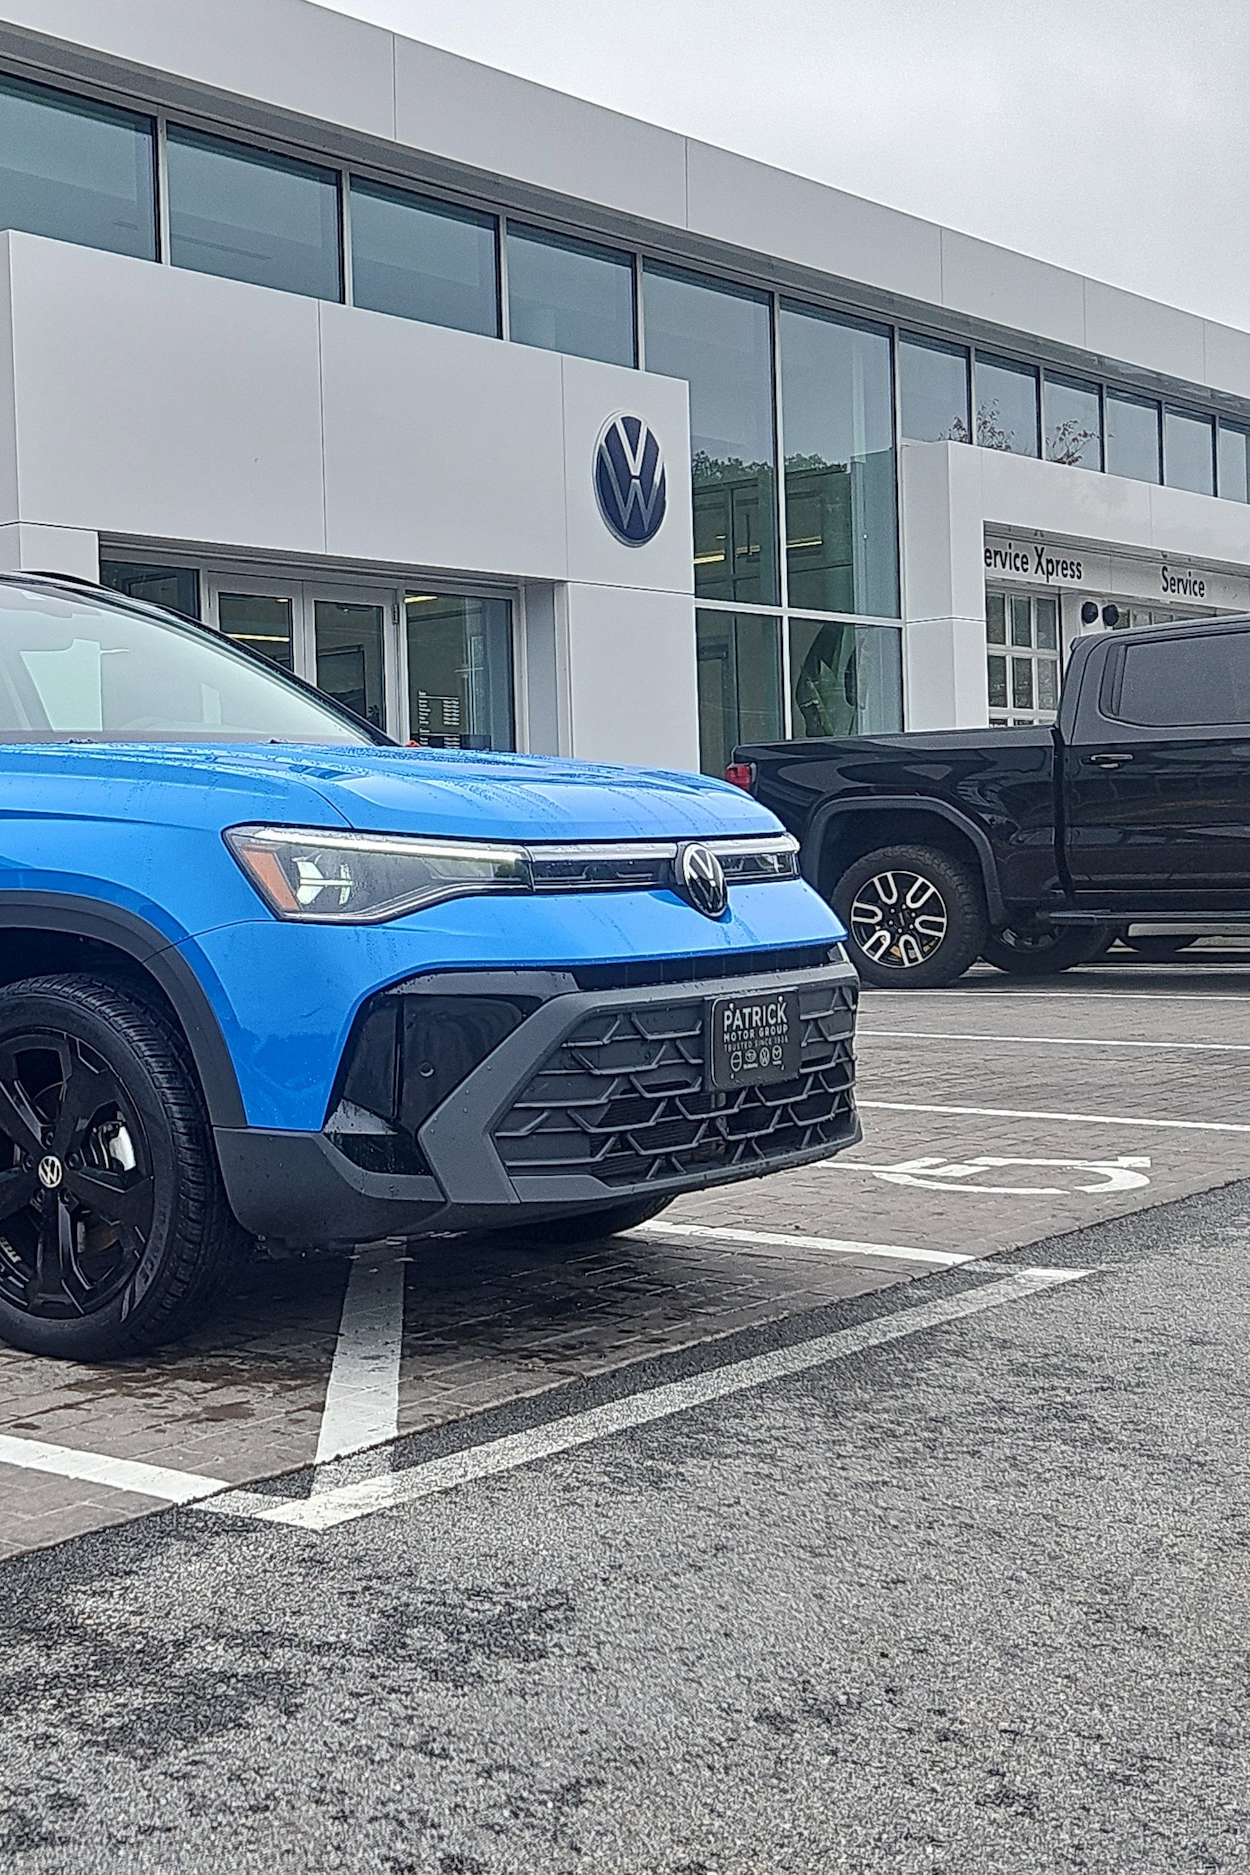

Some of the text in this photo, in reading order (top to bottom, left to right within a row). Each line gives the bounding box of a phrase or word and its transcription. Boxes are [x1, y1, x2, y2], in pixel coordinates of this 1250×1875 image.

[984, 542, 1083, 583] ervice Xpress
[1161, 565, 1206, 598] Service
[723, 1002, 788, 1031] PATRICK
[723, 1024, 788, 1043] MOTOR GROUP
